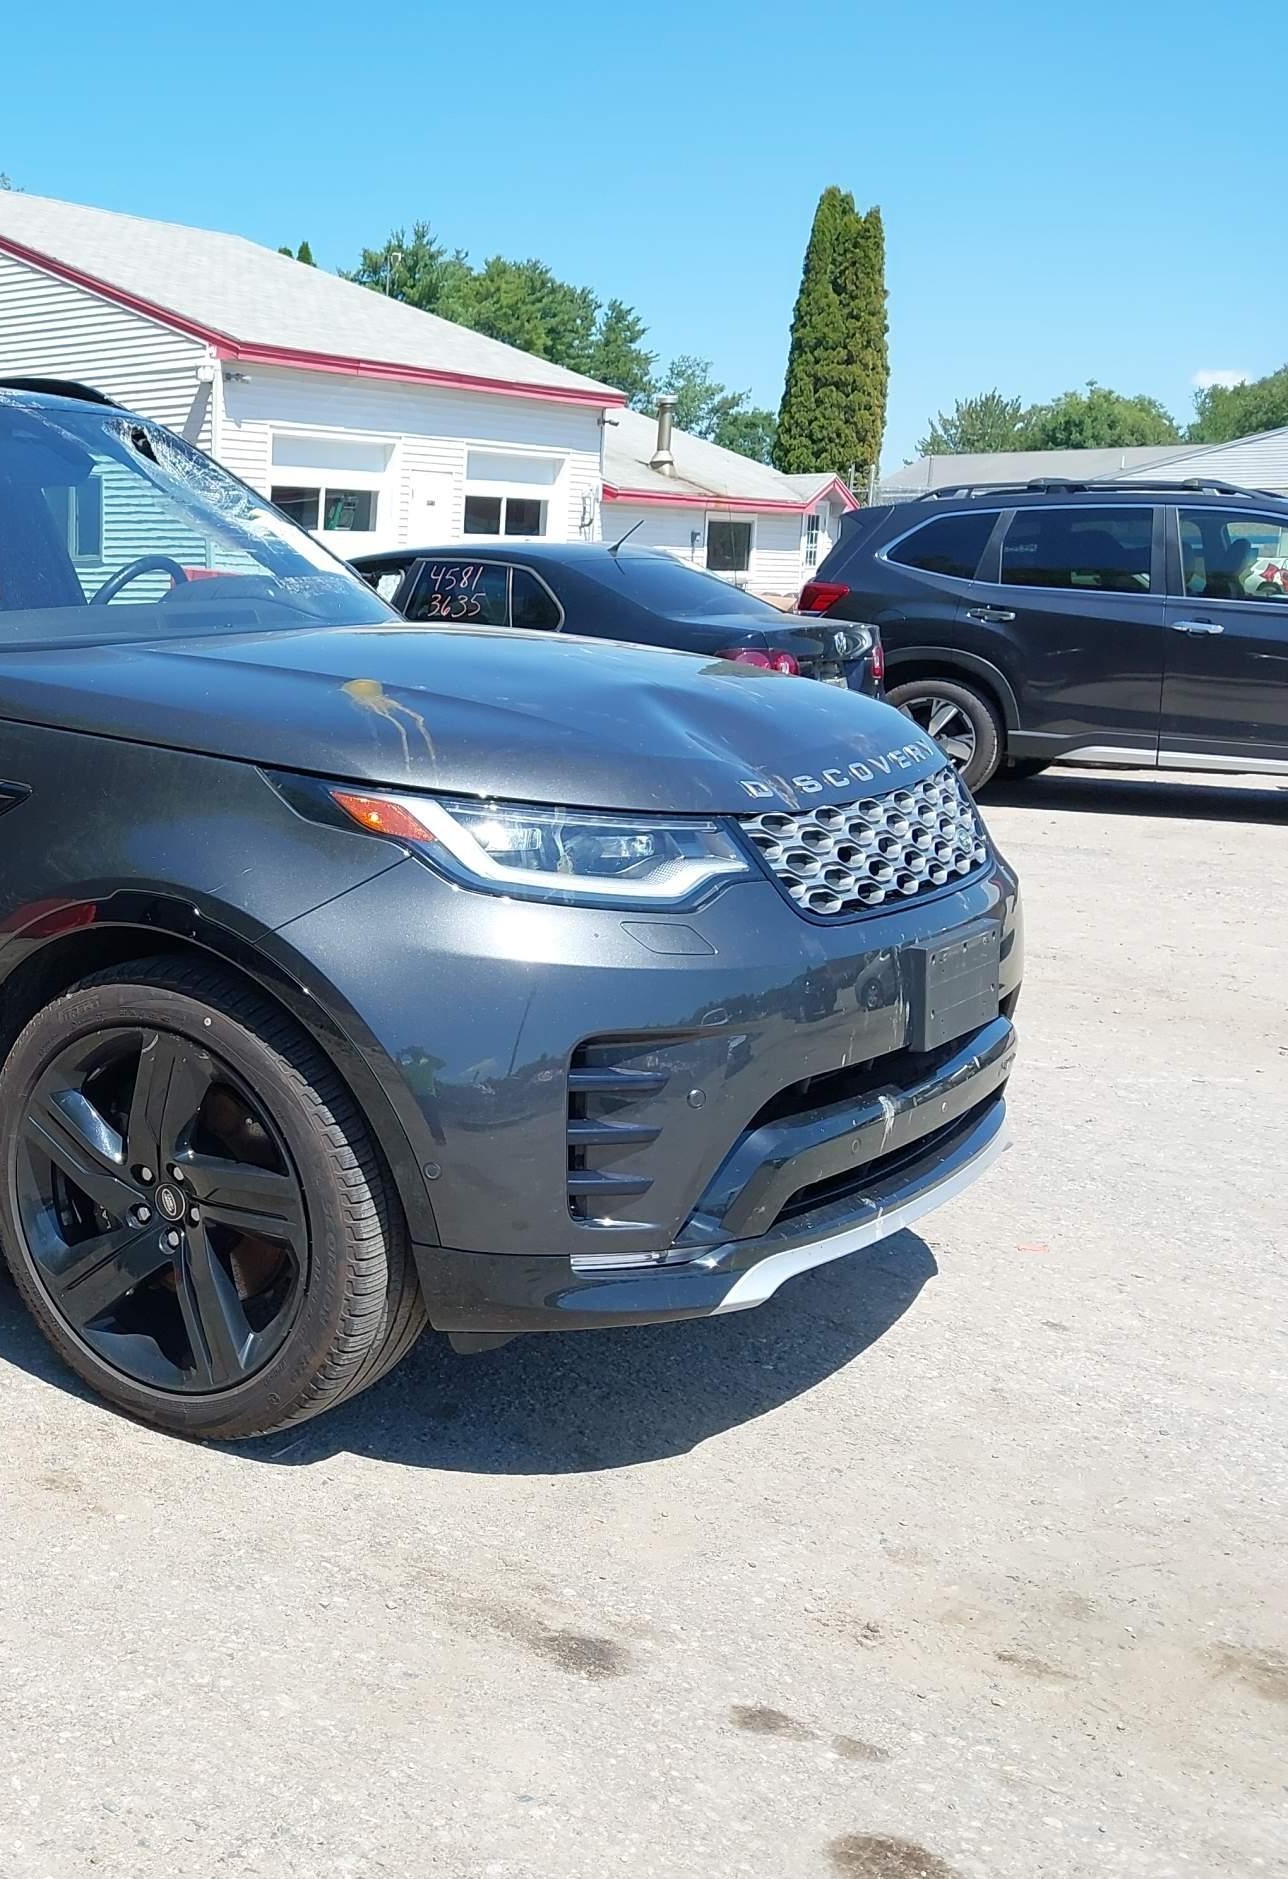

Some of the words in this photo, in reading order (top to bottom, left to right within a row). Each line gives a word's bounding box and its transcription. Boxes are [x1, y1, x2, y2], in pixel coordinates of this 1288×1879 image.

[430, 565, 483, 592] 4581
[427, 593, 486, 618] 3635
[738, 738, 935, 799] DISCOVERY
